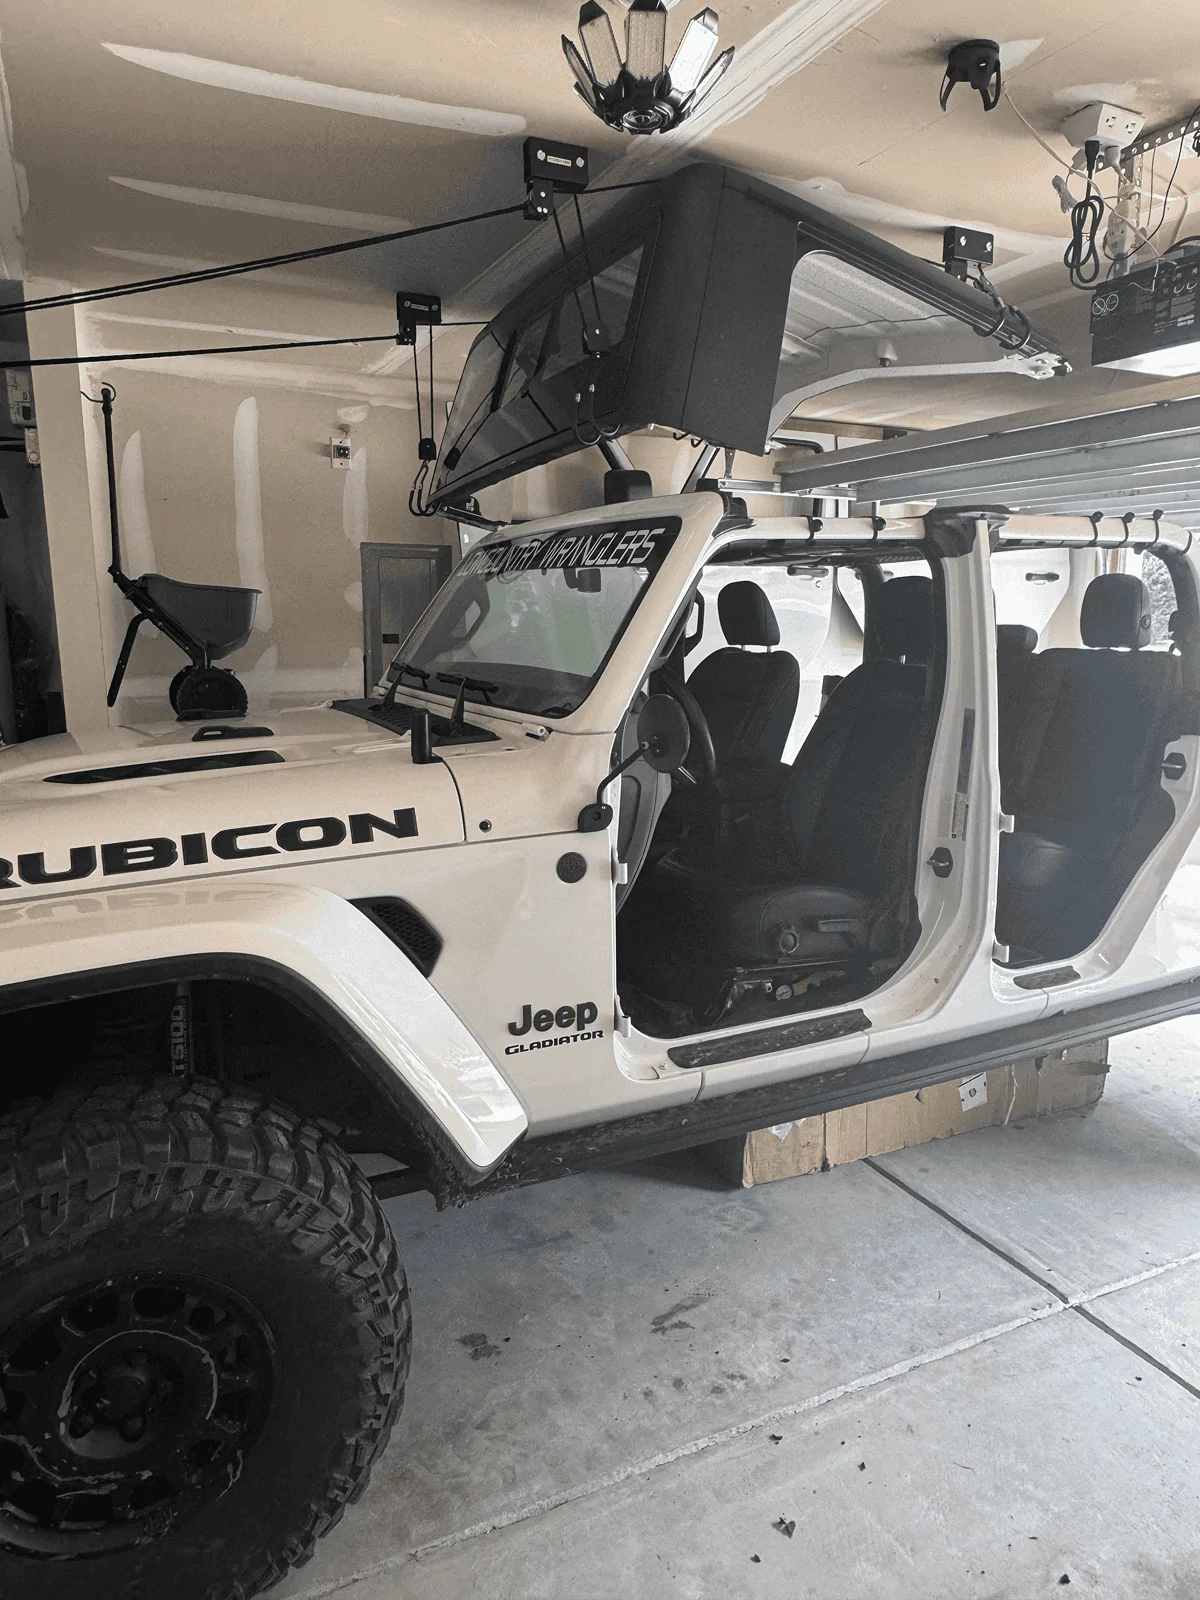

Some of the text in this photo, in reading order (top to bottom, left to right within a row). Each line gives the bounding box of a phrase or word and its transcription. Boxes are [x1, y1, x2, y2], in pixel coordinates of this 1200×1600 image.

[538, 528, 666, 568] WRANGLERS
[0, 807, 419, 889] UBICON
[507, 1001, 598, 1036] Jeep
[504, 1030, 604, 1055] GLADIATOR
